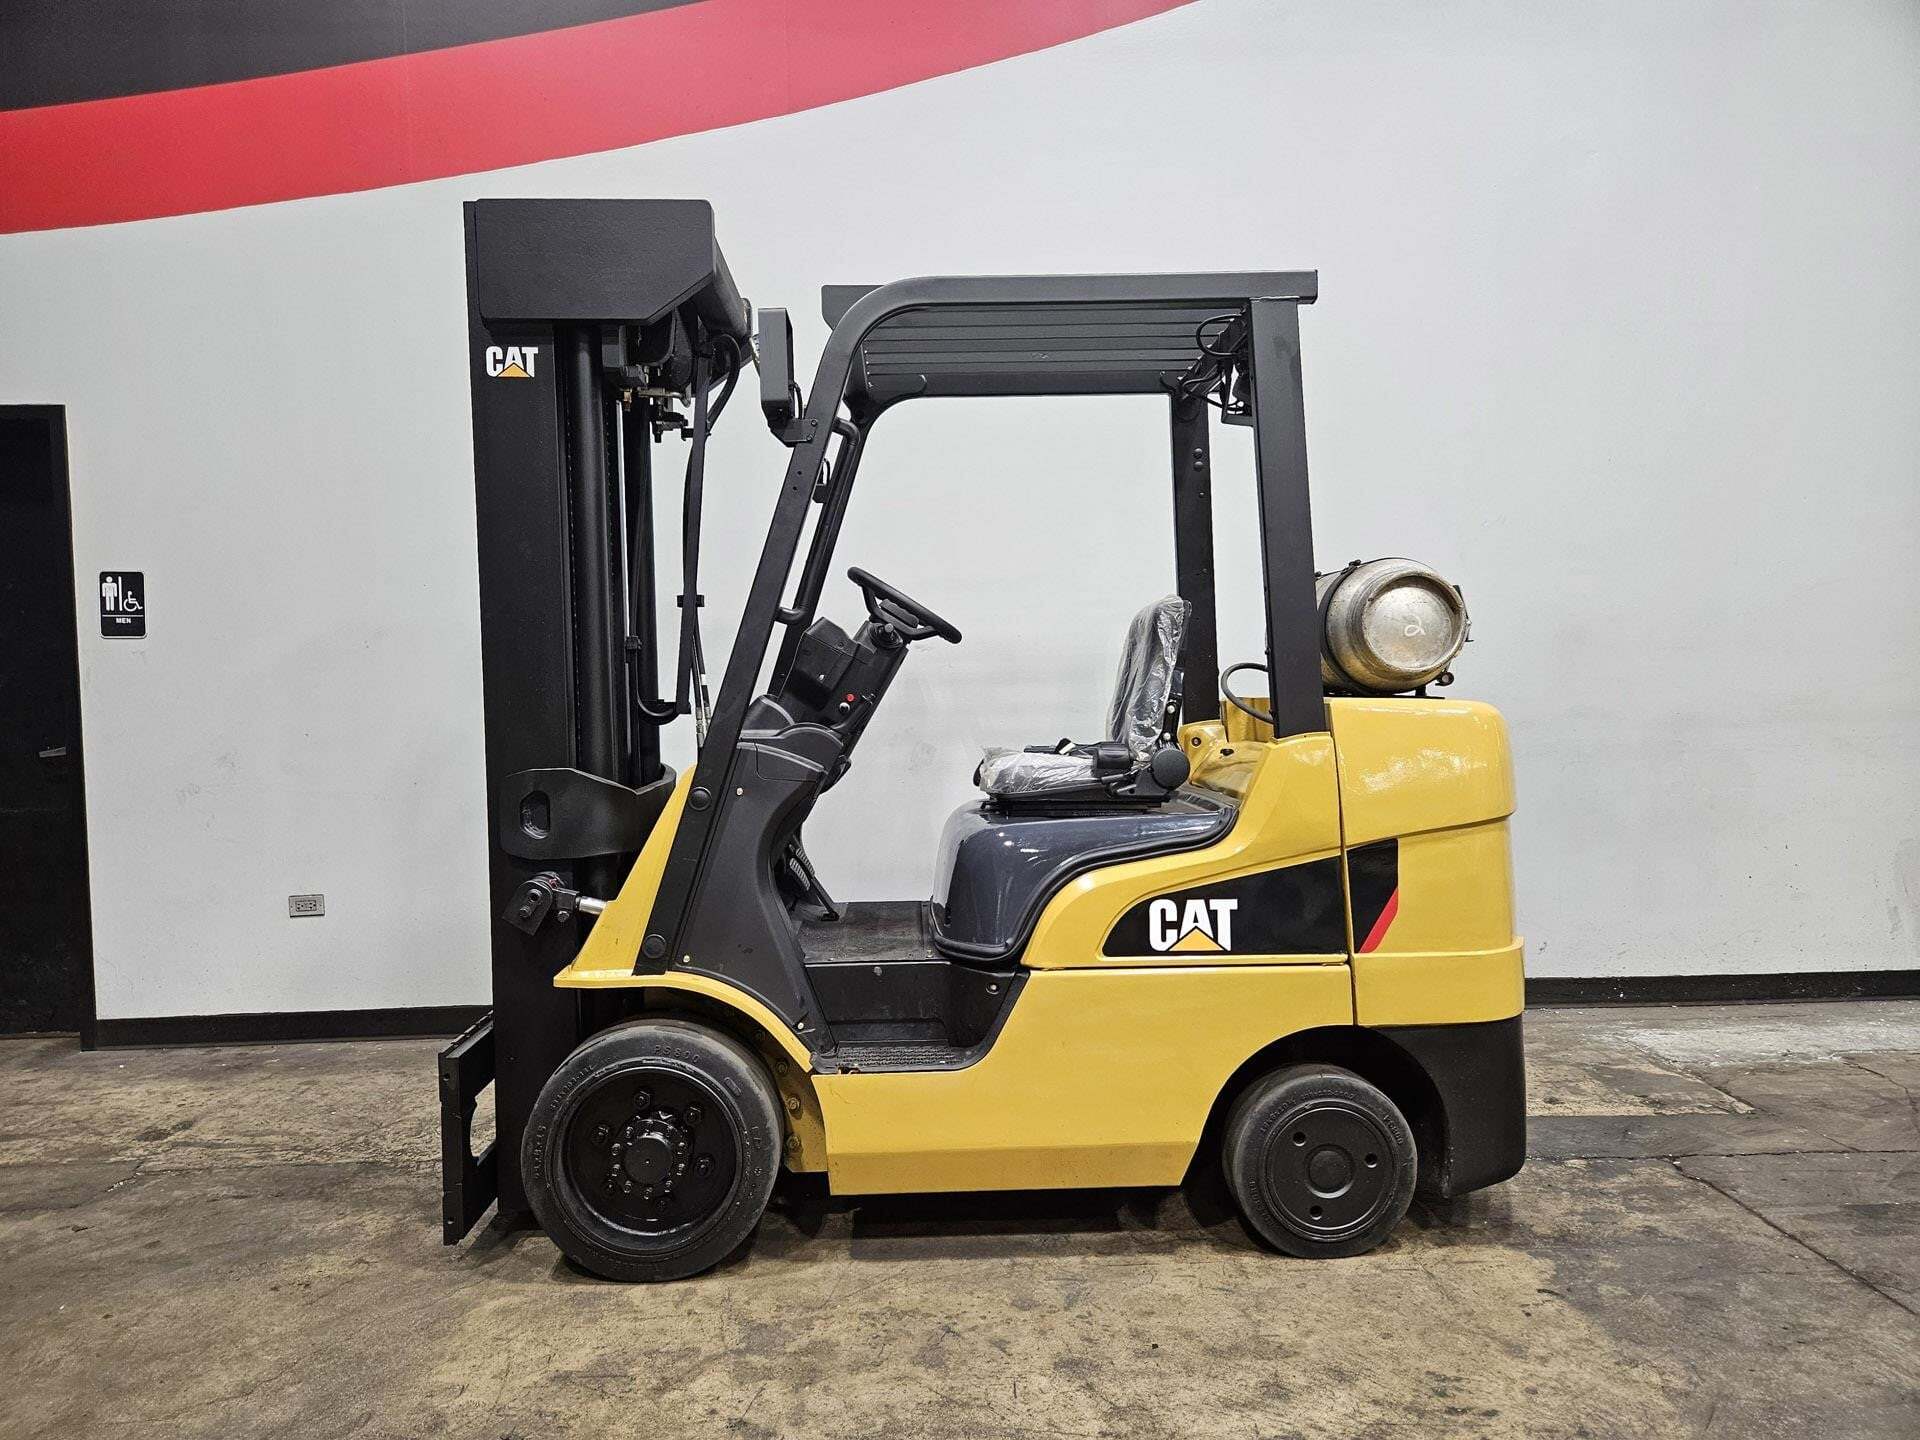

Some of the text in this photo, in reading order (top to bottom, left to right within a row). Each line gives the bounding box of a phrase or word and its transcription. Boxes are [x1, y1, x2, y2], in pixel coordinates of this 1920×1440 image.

[485, 345, 539, 378] CAT
[1404, 614, 1426, 637] 2
[1148, 898, 1239, 952] CAT
